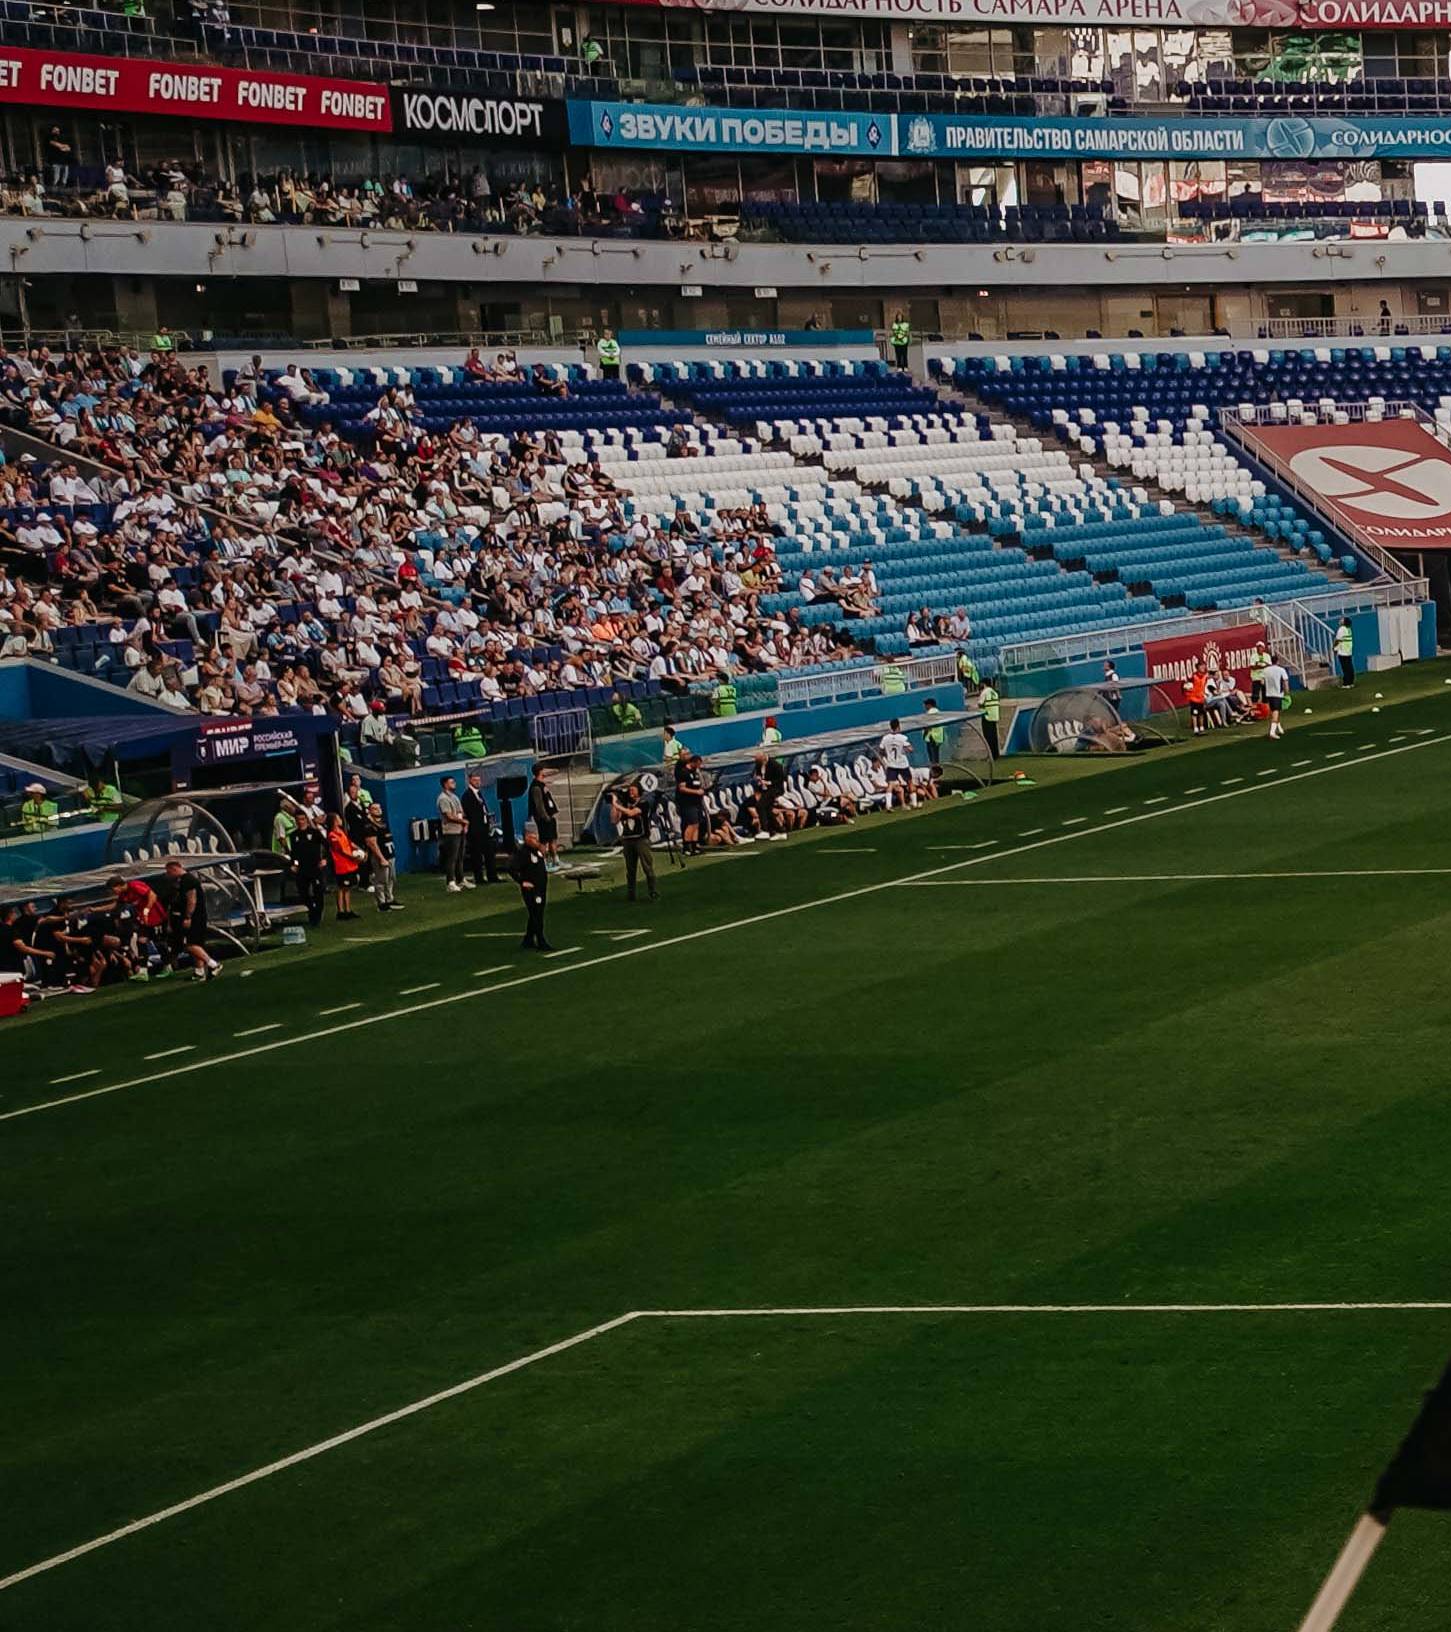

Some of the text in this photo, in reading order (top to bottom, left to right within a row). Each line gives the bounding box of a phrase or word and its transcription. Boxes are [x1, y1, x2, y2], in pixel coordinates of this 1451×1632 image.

[1097, 0, 1182, 19] АРЕНА
[40, 64, 119, 96] FONBET
[148, 72, 222, 103] FONBET
[238, 80, 307, 111] FONBET
[320, 90, 385, 120] FONBET
[619, 112, 858, 151] ЗВУКИ ПОБЕДЫ
[945, 124, 1244, 152] ПРАВИТЕЛЬСТВО САМАРСКОЙ ОБЛАСТИ
[215, 737, 249, 758] МИР
